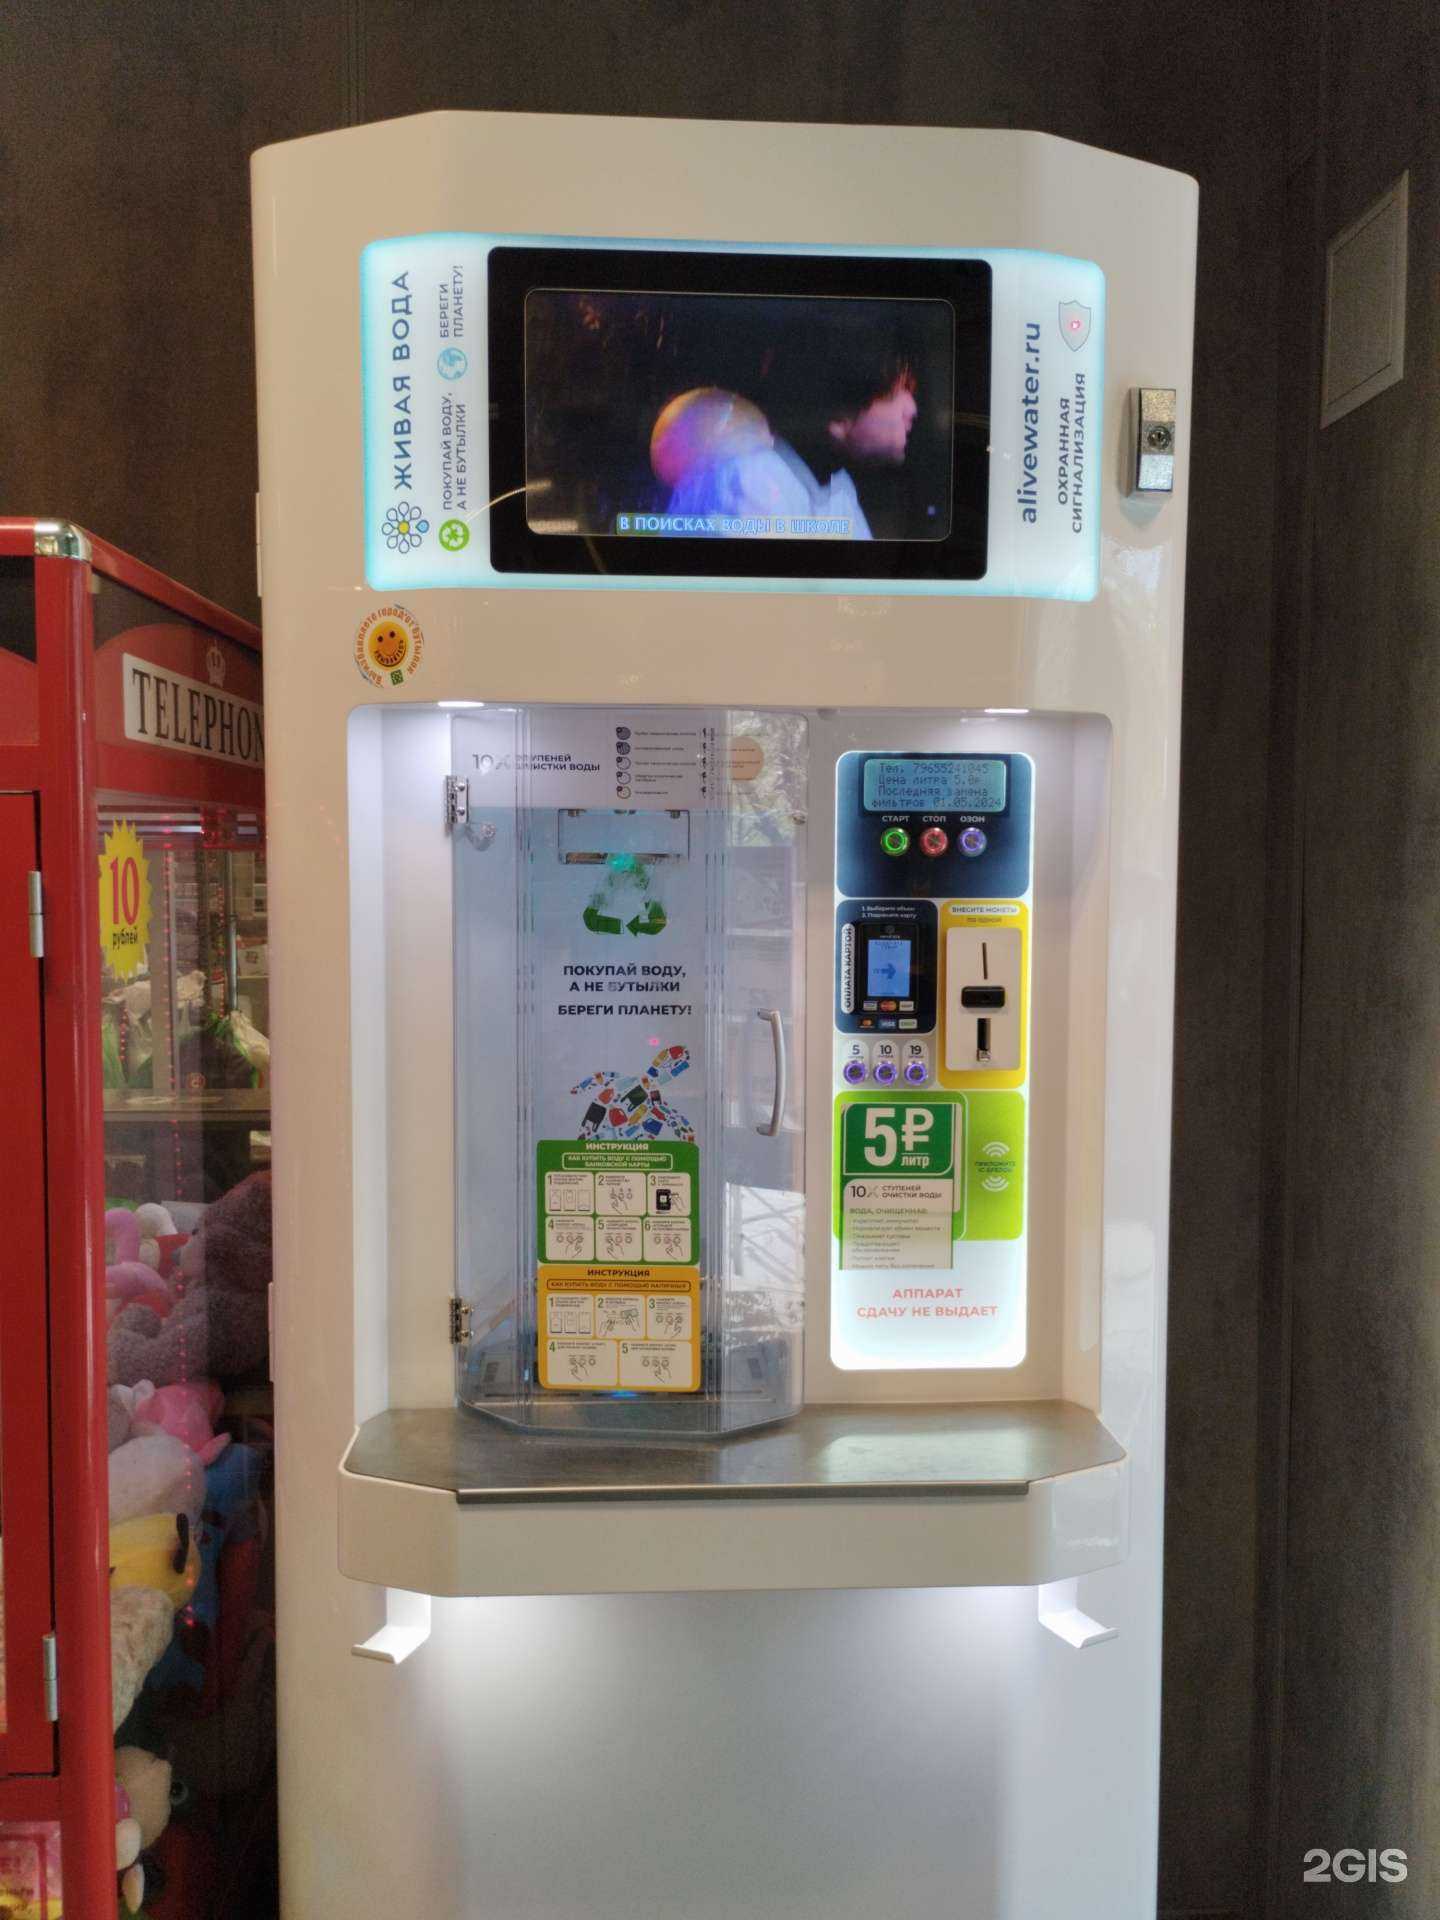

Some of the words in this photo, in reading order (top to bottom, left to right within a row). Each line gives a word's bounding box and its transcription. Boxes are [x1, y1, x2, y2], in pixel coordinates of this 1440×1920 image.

[453, 265, 464, 338] ПЛАНЕТУ!
[390, 271, 414, 360] ВОДА
[439, 284, 449, 338] БЕРЕГИ
[442, 392, 453, 436] ВОДУ,
[1016, 322, 1041, 524] alivewater.ru
[392, 375, 412, 490] ЖИВАЯ
[455, 403, 467, 474] БУТЫЛКИ
[1058, 398, 1070, 505] ОХРАННАЯ
[1072, 372, 1087, 533] СИГНАЛИЗАЦИЯ
[442, 441, 452, 510] ПОКУПАЙ
[456, 477, 466, 495] НЕ
[456, 500, 467, 510] А
[620, 516, 630, 530] В
[634, 517, 715, 531] ПОИСКАХ
[723, 519, 771, 535] ВОДЫ
[776, 519, 785, 533] В
[791, 519, 850, 534] ШКОЛЕ
[570, 763, 600, 772] ВОДЫ
[882, 815, 910, 823] СТАРТ
[922, 815, 946, 823] СТОП
[960, 815, 986, 823] ОЗОН
[109, 857, 140, 926] 10
[112, 927, 139, 950] рублей
[843, 928, 851, 967] КАРТОЙ
[564, 963, 637, 976] ПОКУПАЙ
[641, 965, 686, 978] ВОДУ,
[569, 982, 580, 992] А
[584, 982, 603, 992] НЕ
[607, 981, 680, 992] БУТЫЛКИ
[843, 968, 851, 1008] ОПЛАТА
[558, 1005, 614, 1015] БЕРЕГИ
[618, 1005, 692, 1015] ПЛАНЕТУ!
[852, 1045, 860, 1055] 5
[880, 1045, 892, 1055] 10
[910, 1045, 922, 1055] 19
[586, 1143, 649, 1151] ИНСТРУКЦИЯ
[901, 1155, 930, 1169] литр
[587, 1269, 650, 1277] ИНСТРУКЦИЯ
[892, 1288, 963, 1299] АППАРАТ
[857, 1306, 906, 1318] СДАЧУ
[912, 1306, 930, 1316] НЕ
[935, 1305, 997, 1318] ВЫДАЕТ
